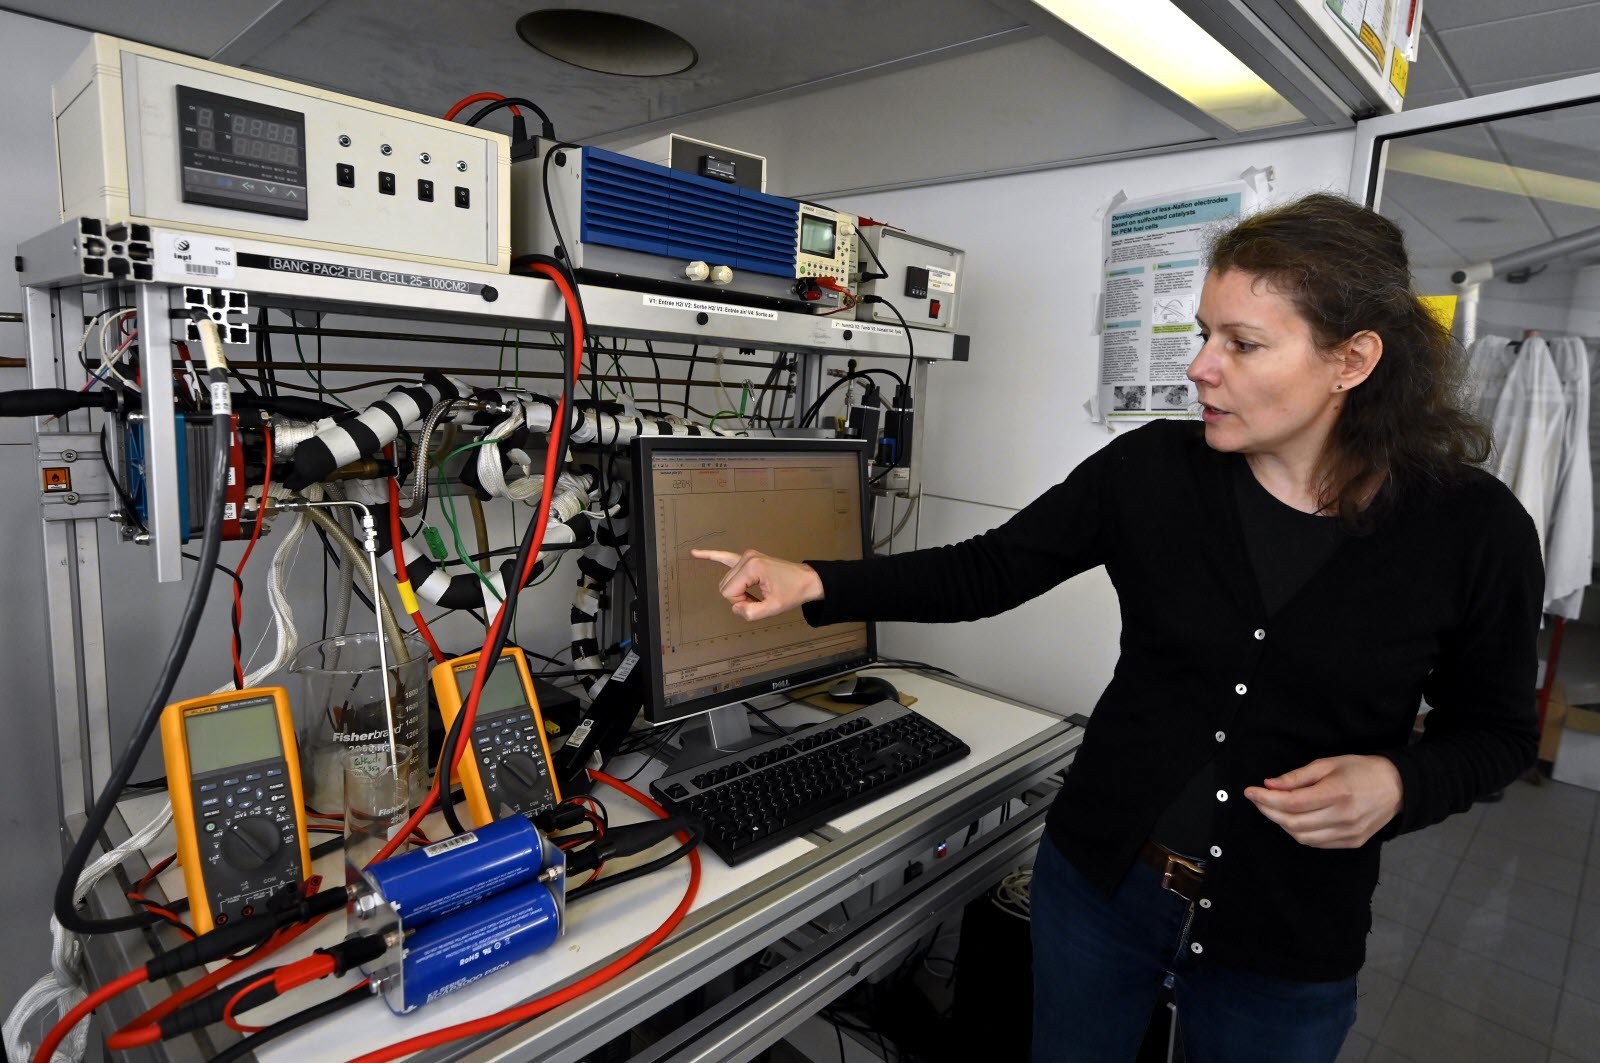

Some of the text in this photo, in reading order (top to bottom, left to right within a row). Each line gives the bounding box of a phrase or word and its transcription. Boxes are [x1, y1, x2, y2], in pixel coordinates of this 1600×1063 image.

[1112, 210, 1150, 221] Developments
[1159, 202, 1192, 212] less-Nafion
[1194, 197, 1228, 206] electrodes
[1137, 214, 1167, 224] sulfonated
[1168, 209, 1196, 219] catalysts
[274, 258, 466, 292] BANC PAC2 FUEL CELL 25-100CM2
[772, 680, 790, 690] DELL
[405, 688, 418, 698] 1800
[405, 702, 419, 712] 1600
[406, 716, 419, 726] 1400
[332, 723, 402, 742] Fisherbrad
[406, 729, 419, 740] 1200
[460, 952, 480, 966] RoHS
